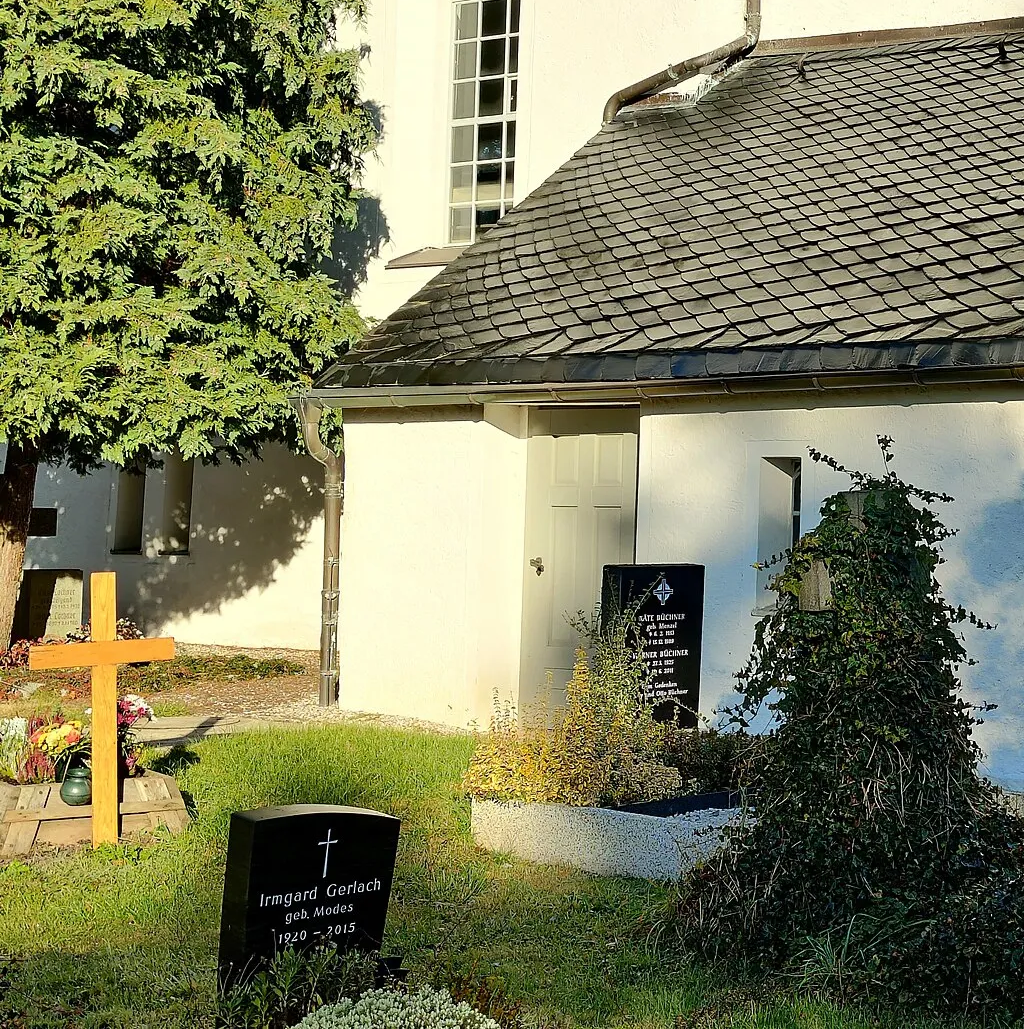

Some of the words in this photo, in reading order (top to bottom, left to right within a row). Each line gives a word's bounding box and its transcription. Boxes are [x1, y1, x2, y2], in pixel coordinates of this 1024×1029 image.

[260, 886, 318, 907] Irmgard
[326, 878, 382, 898] Gerlach
[285, 908, 310, 925] geb.
[313, 903, 354, 917] Modes
[279, 929, 307, 944] 1920
[325, 921, 356, 937] 2015
